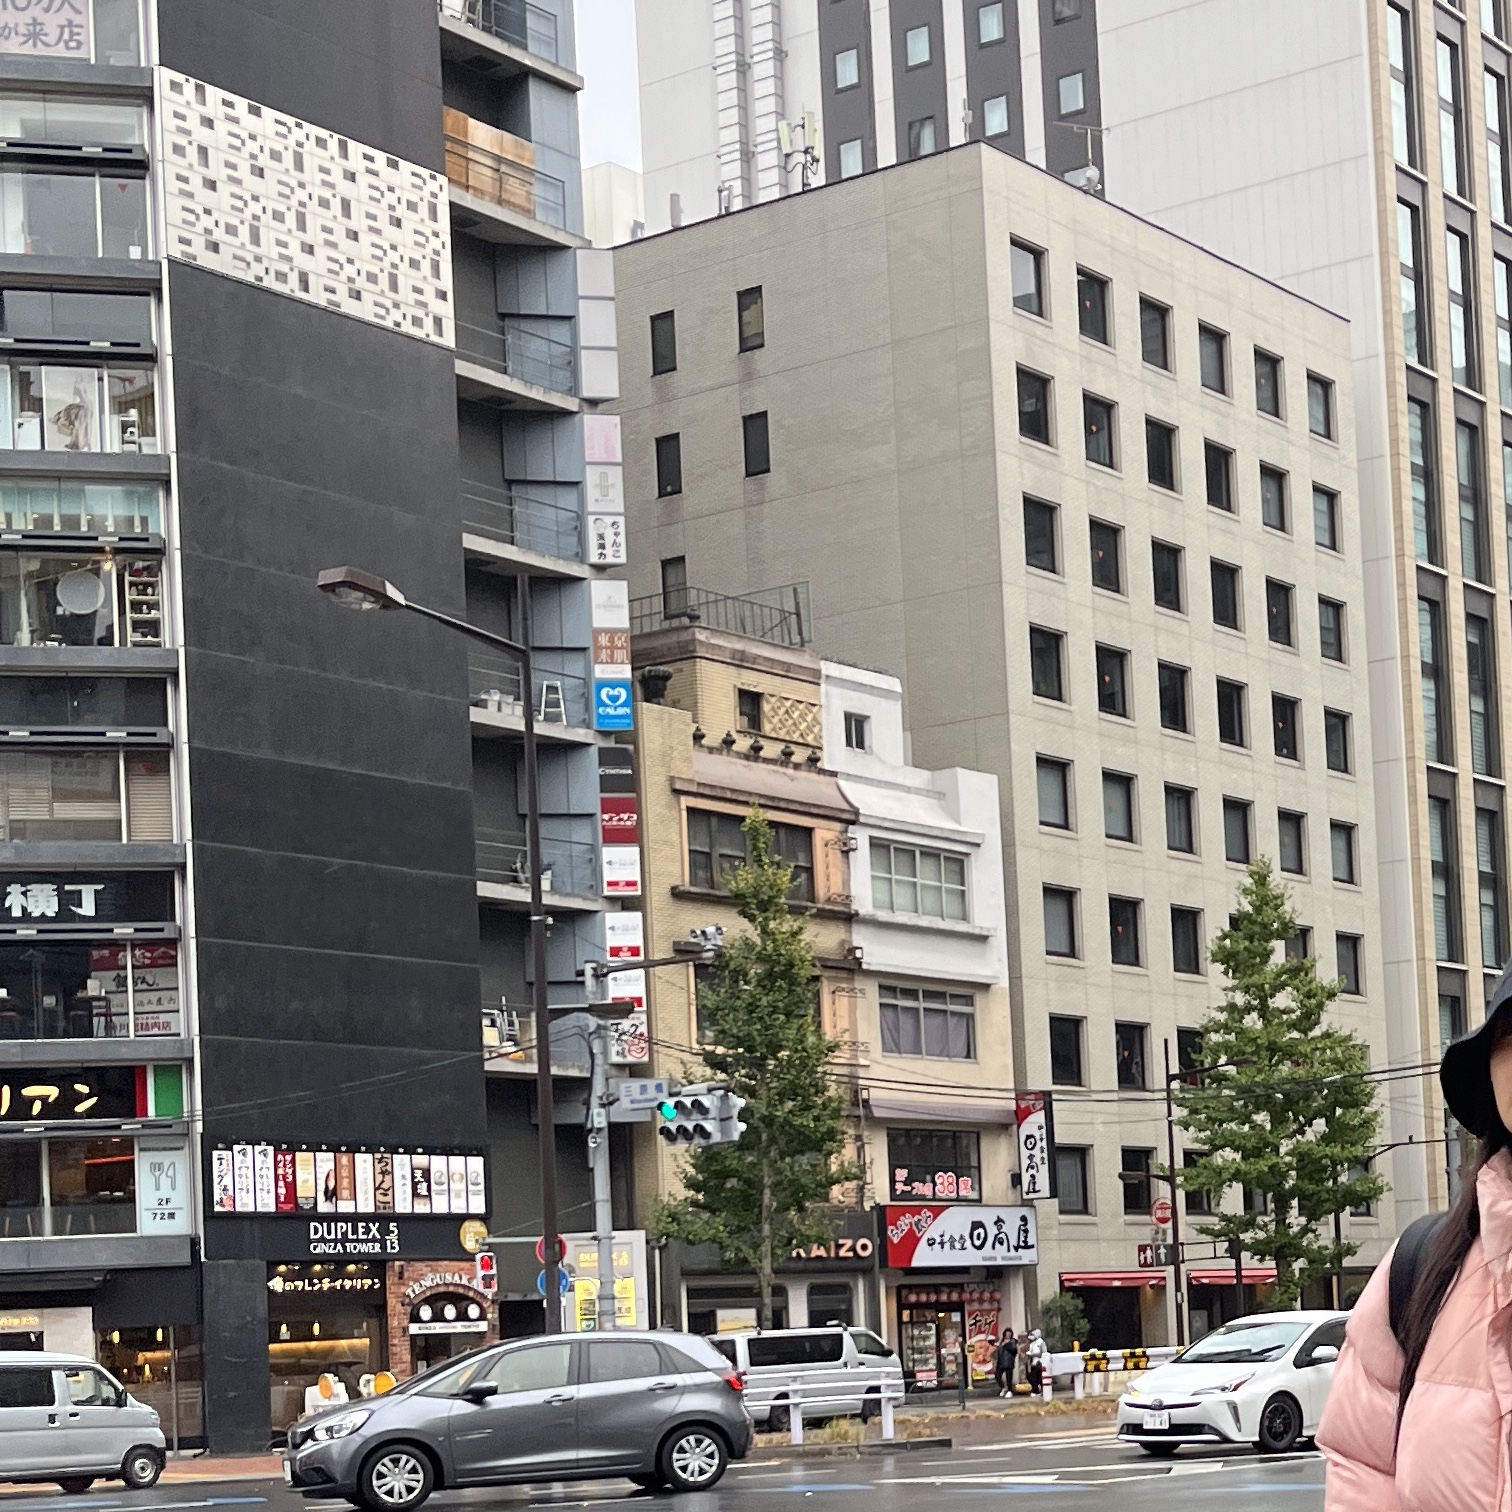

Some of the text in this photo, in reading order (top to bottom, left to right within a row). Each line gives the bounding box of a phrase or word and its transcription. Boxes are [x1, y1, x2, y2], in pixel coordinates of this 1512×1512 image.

[5, 883, 105, 917] 横丁
[1024, 1134, 1041, 1195] 日高屋
[375, 1154, 393, 1205] ちゃんこ
[157, 1197, 172, 1206] 2F
[309, 1222, 399, 1239] DUPLEX 5
[927, 1230, 967, 1252] 中華食堂
[969, 1214, 1035, 1253] 日高屋
[309, 1240, 399, 1253] GINZA TOWER 13
